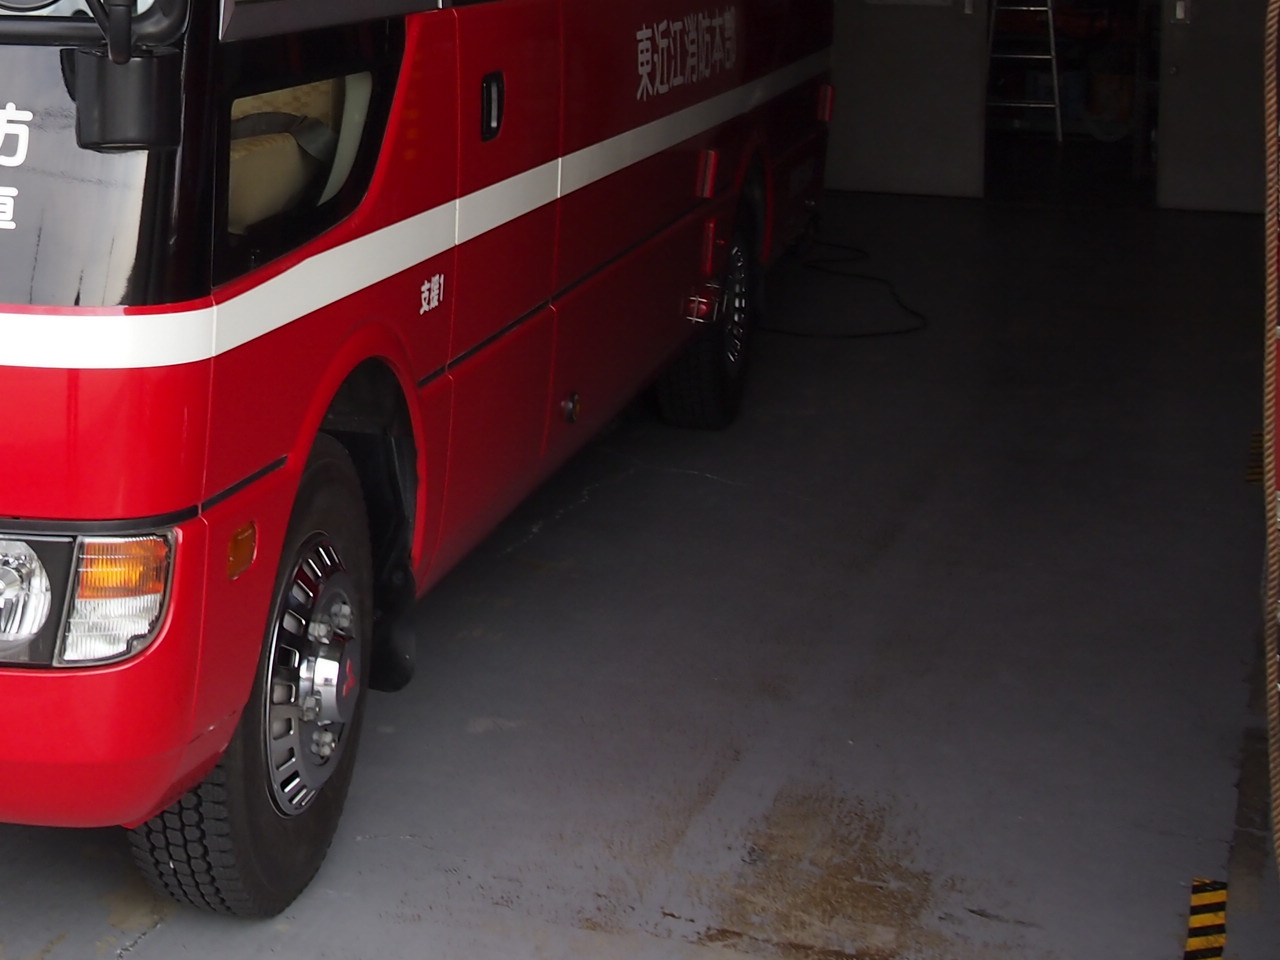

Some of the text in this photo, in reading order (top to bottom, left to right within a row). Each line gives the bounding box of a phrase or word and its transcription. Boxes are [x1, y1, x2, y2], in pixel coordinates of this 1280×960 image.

[635, 4, 736, 102] 東近江消防本部
[419, 273, 445, 316] 支援1
